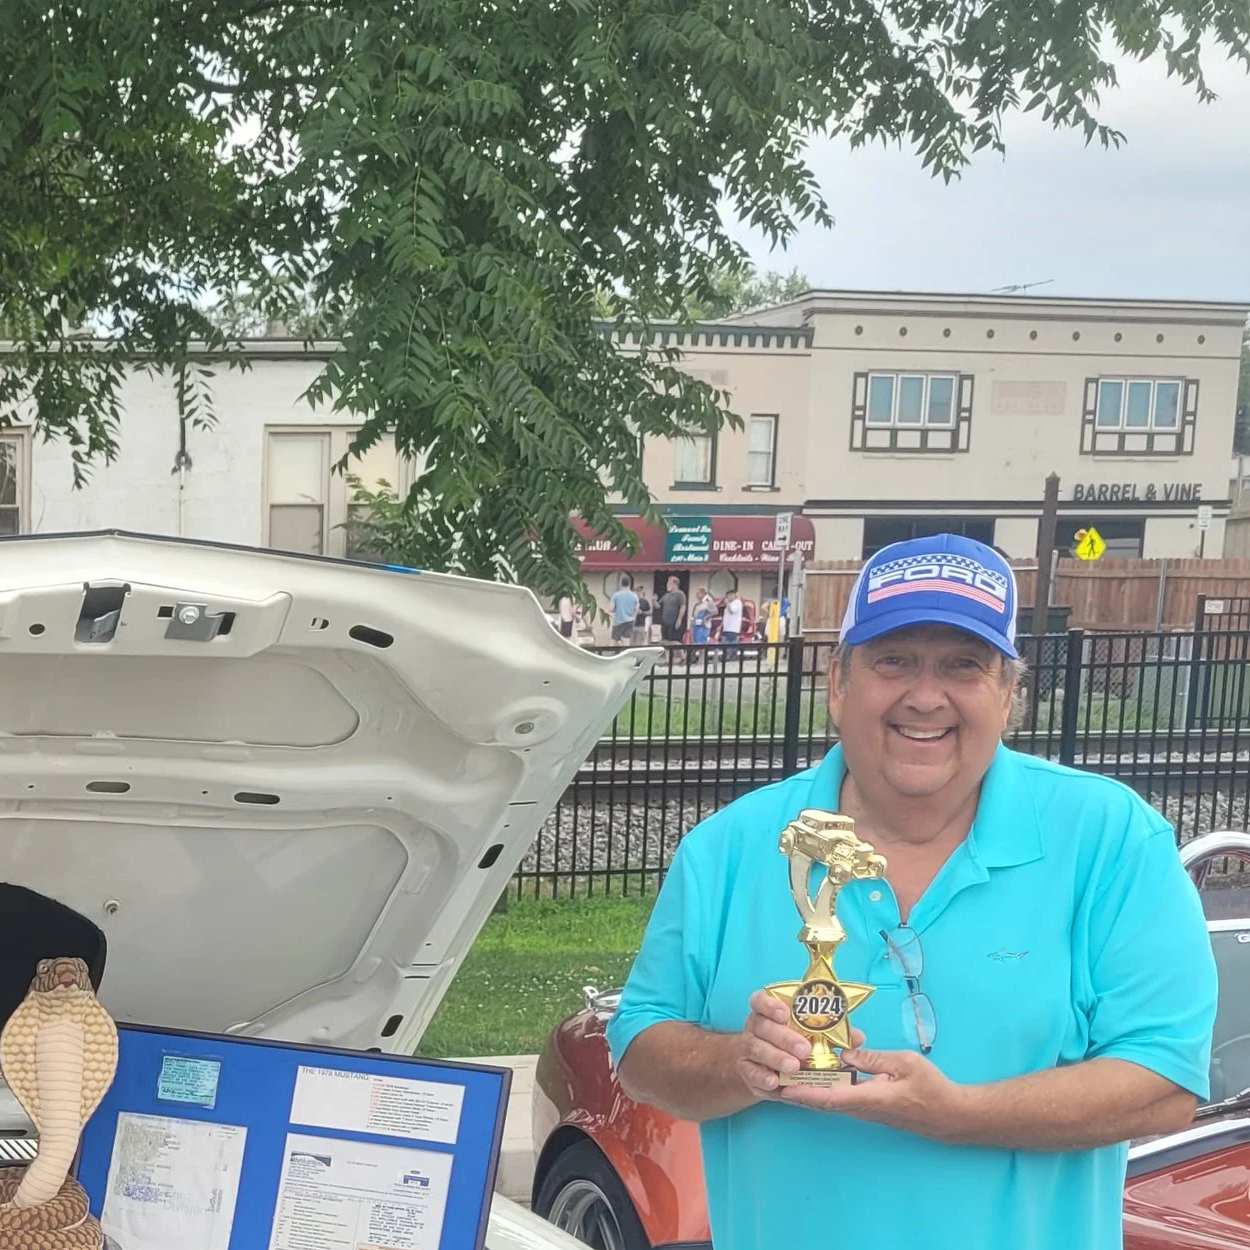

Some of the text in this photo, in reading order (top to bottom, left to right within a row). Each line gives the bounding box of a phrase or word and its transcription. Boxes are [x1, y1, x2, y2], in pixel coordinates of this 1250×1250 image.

[1073, 483, 1203, 501] BARREL & VINE
[713, 540, 754, 551] DINE-IN
[867, 565, 1007, 601] FORD
[797, 996, 841, 1015] 2024
[302, 1067, 316, 1075] THE
[334, 1071, 369, 1080] MUSTANG
